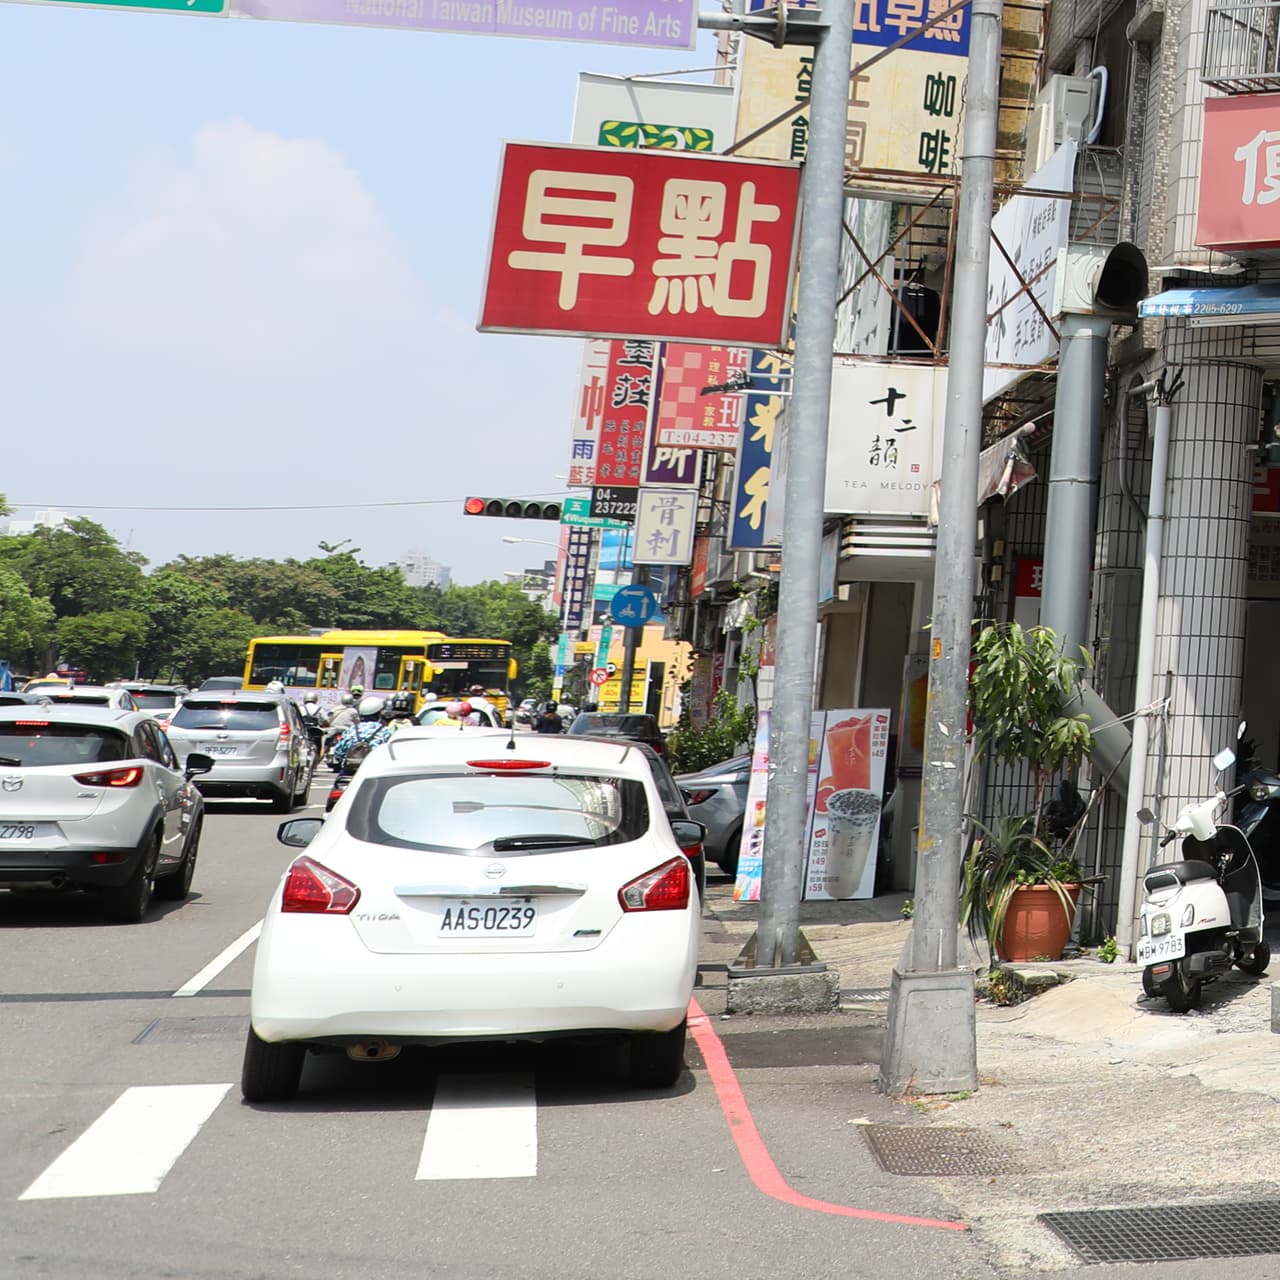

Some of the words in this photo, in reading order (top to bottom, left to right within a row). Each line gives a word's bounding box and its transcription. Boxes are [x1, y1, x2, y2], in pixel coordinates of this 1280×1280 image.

[496, 0, 575, 30] Museum
[578, 10, 598, 31] of
[603, 8, 639, 34] Fine
[643, 11, 681, 39] Arts
[508, 169, 779, 318] 早點
[869, 387, 917, 469] 十二韻
[597, 489, 618, 500] 04-
[844, 481, 867, 489] TEA
[881, 482, 929, 491] MELODY
[647, 496, 685, 558] 骨刺
